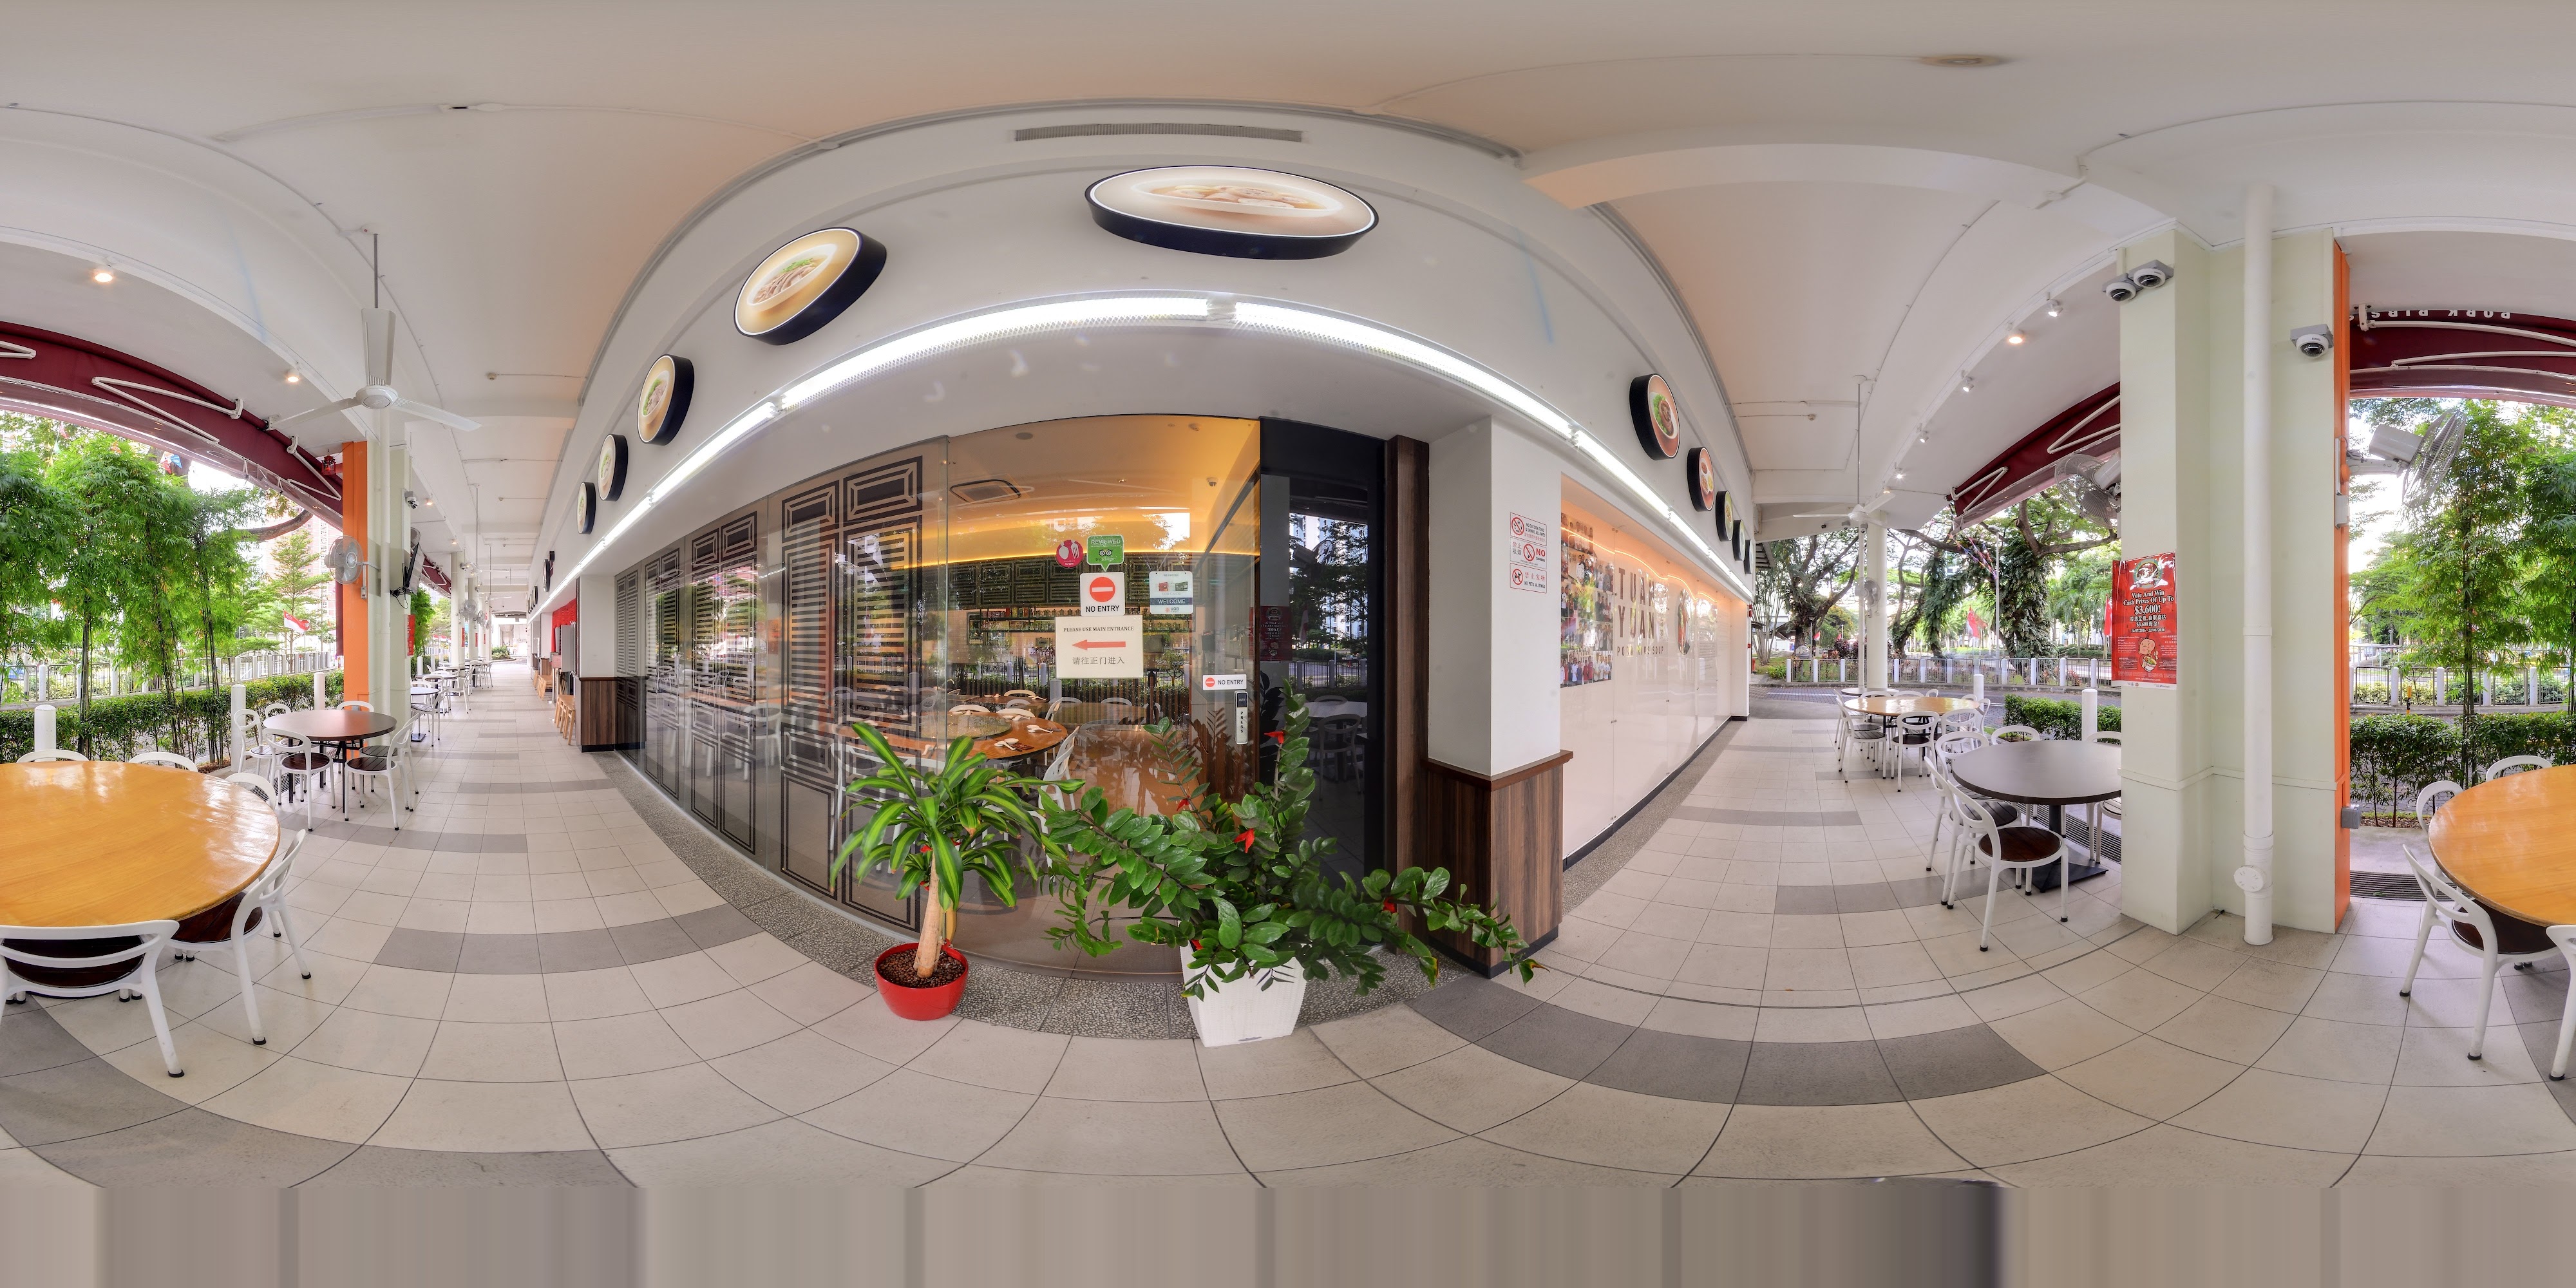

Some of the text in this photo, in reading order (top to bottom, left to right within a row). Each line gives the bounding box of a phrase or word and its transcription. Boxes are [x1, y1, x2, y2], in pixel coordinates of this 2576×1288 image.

[1536, 548, 1546, 556] NO
[1618, 567, 1654, 607] TUAN
[2158, 596, 2166, 604] Up
[2134, 605, 2161, 616] $3,600!
[1618, 605, 1654, 639] YUAN
[1617, 645, 1663, 656] PORK RIBS SOUP
[1073, 656, 1125, 665] 请往正门进入
